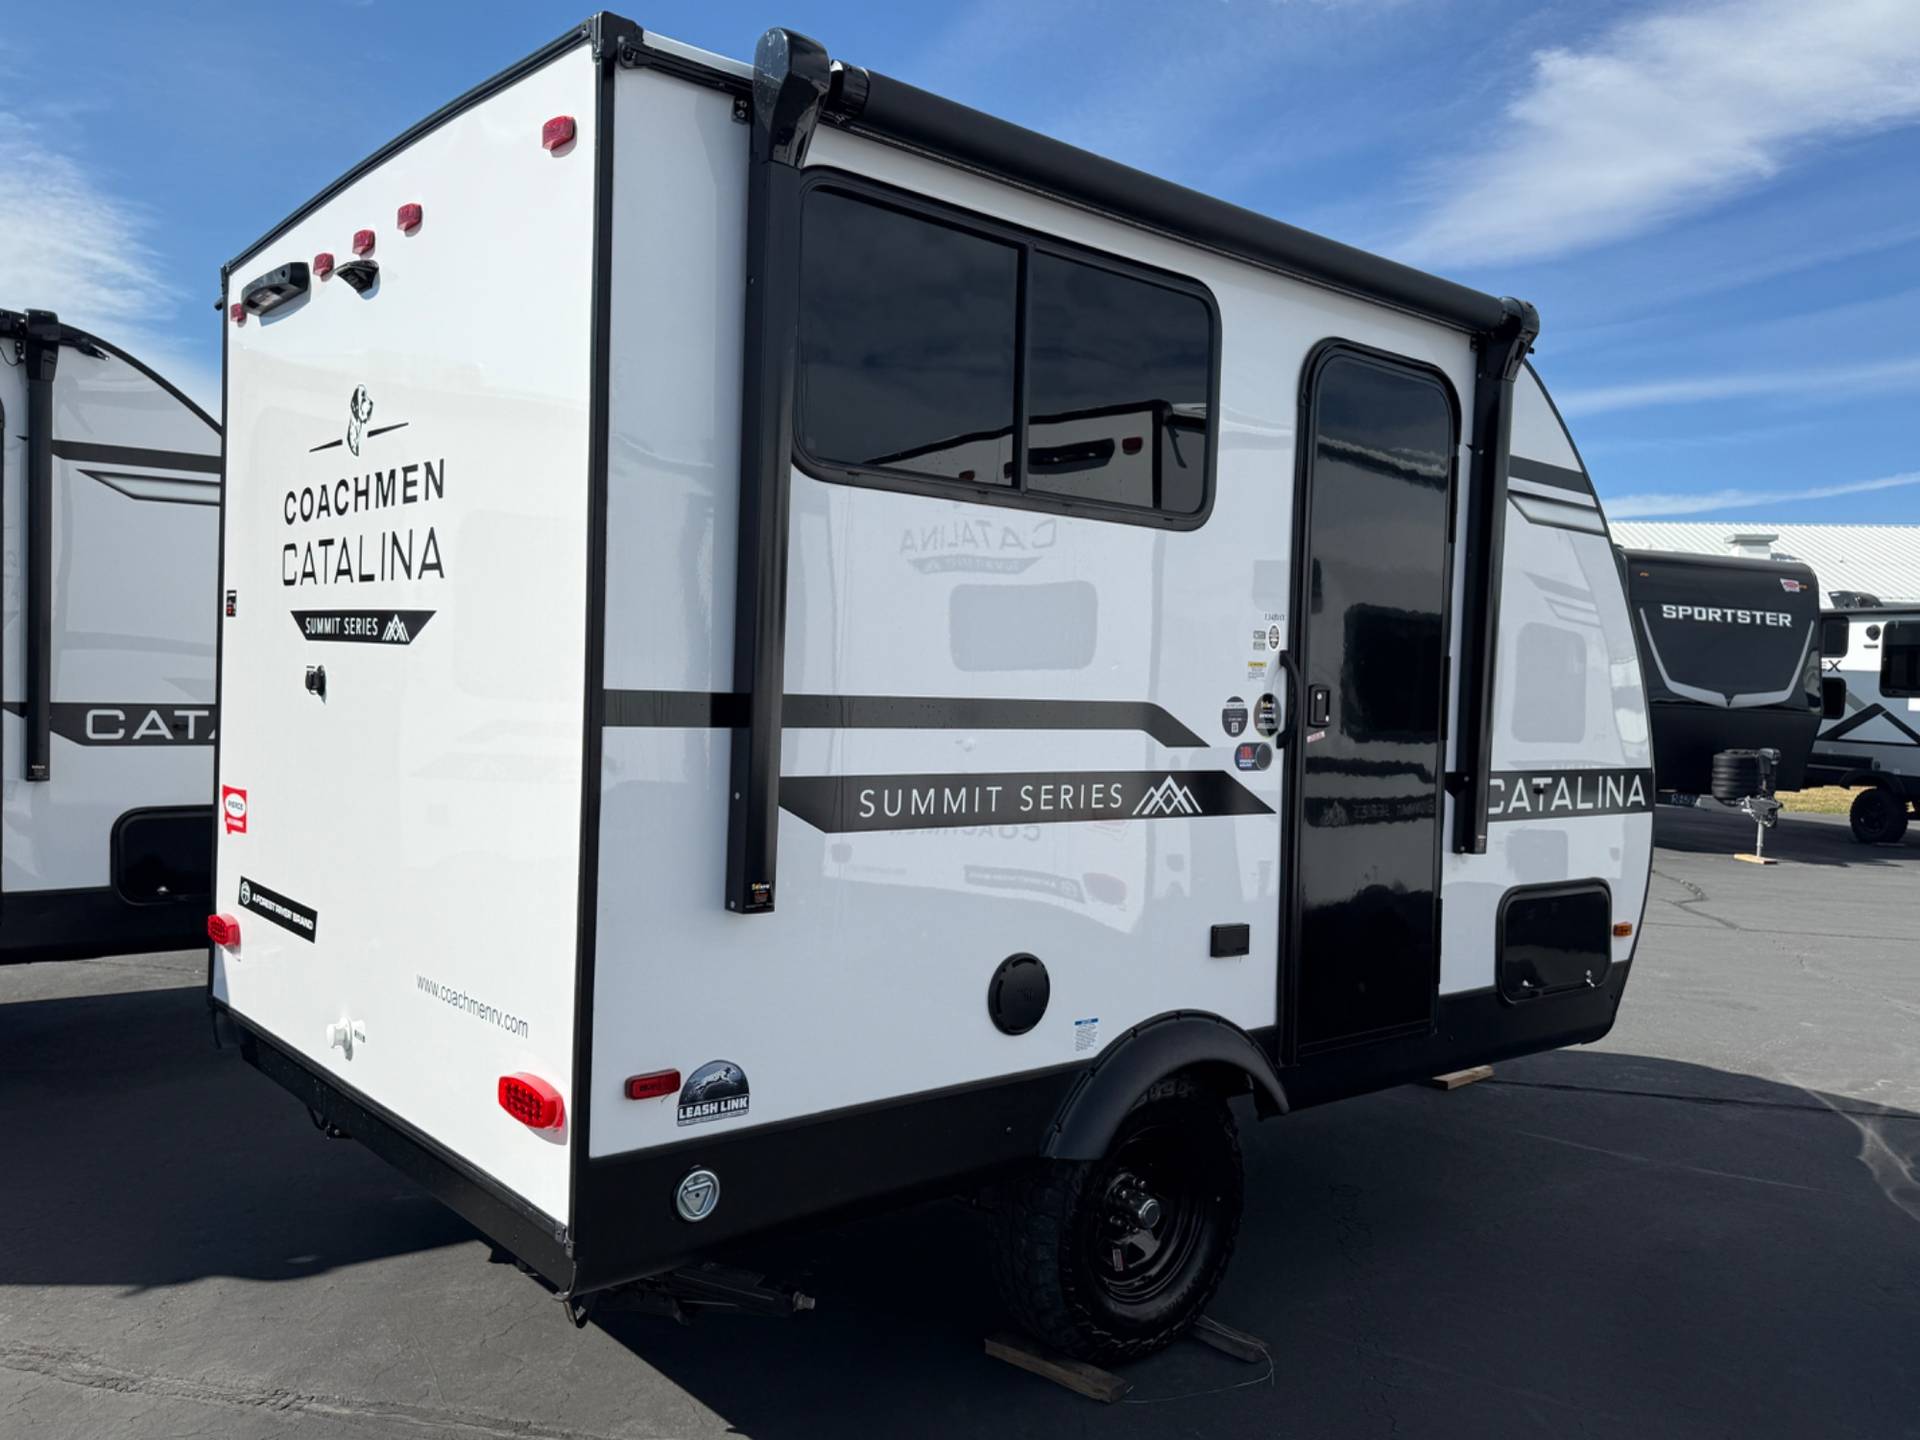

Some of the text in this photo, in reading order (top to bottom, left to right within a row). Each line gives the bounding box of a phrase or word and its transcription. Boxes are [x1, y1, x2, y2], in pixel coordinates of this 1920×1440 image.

[284, 458, 444, 525] COACHMEN
[282, 526, 445, 586] CATALINA
[305, 617, 378, 637] SUMMIT SERIES
[1661, 604, 1792, 628] SPORTSTER
[86, 709, 216, 740] CAT
[858, 782, 1123, 818] SUMMIT SERIES
[1488, 774, 1646, 815] CATALINA
[416, 974, 529, 1039] www.coachmenrv.com
[679, 1096, 748, 1120] LEASH LINK
